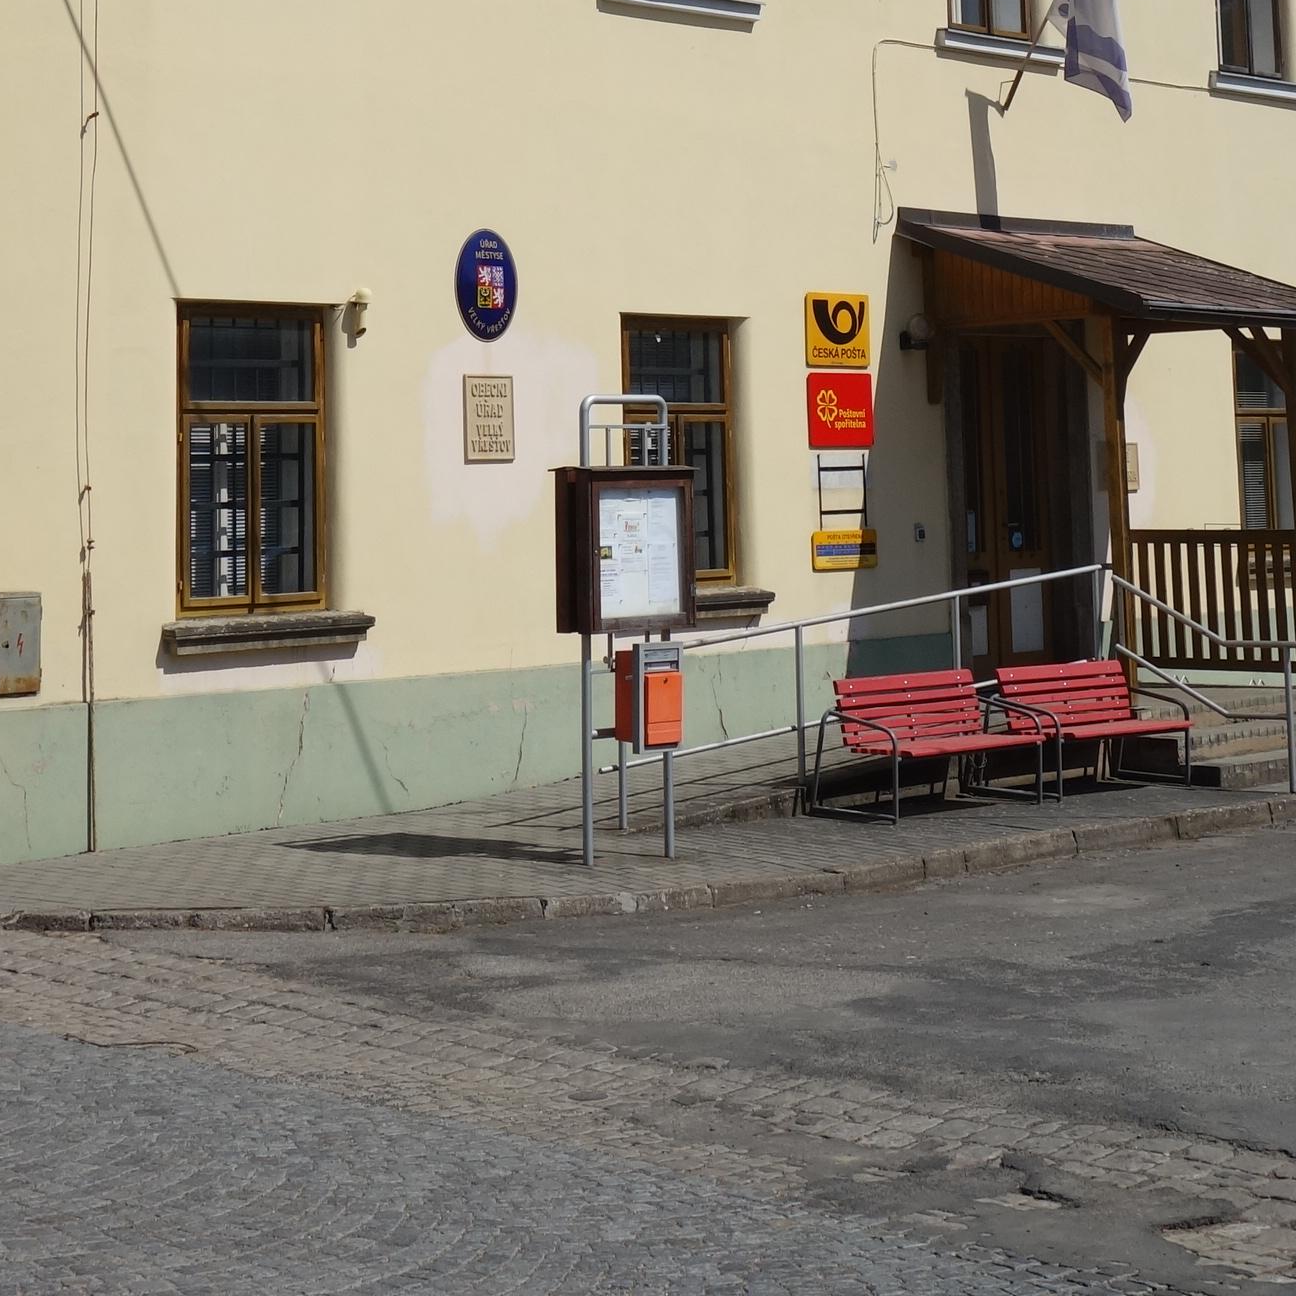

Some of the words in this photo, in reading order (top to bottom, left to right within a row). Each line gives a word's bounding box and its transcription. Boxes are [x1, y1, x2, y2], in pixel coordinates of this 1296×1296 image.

[479, 239, 498, 249] ÚŘAD
[475, 250, 504, 260] MĚSTYSE
[812, 345, 840, 358] ČESKÁ
[841, 347, 866, 359] POŠTA
